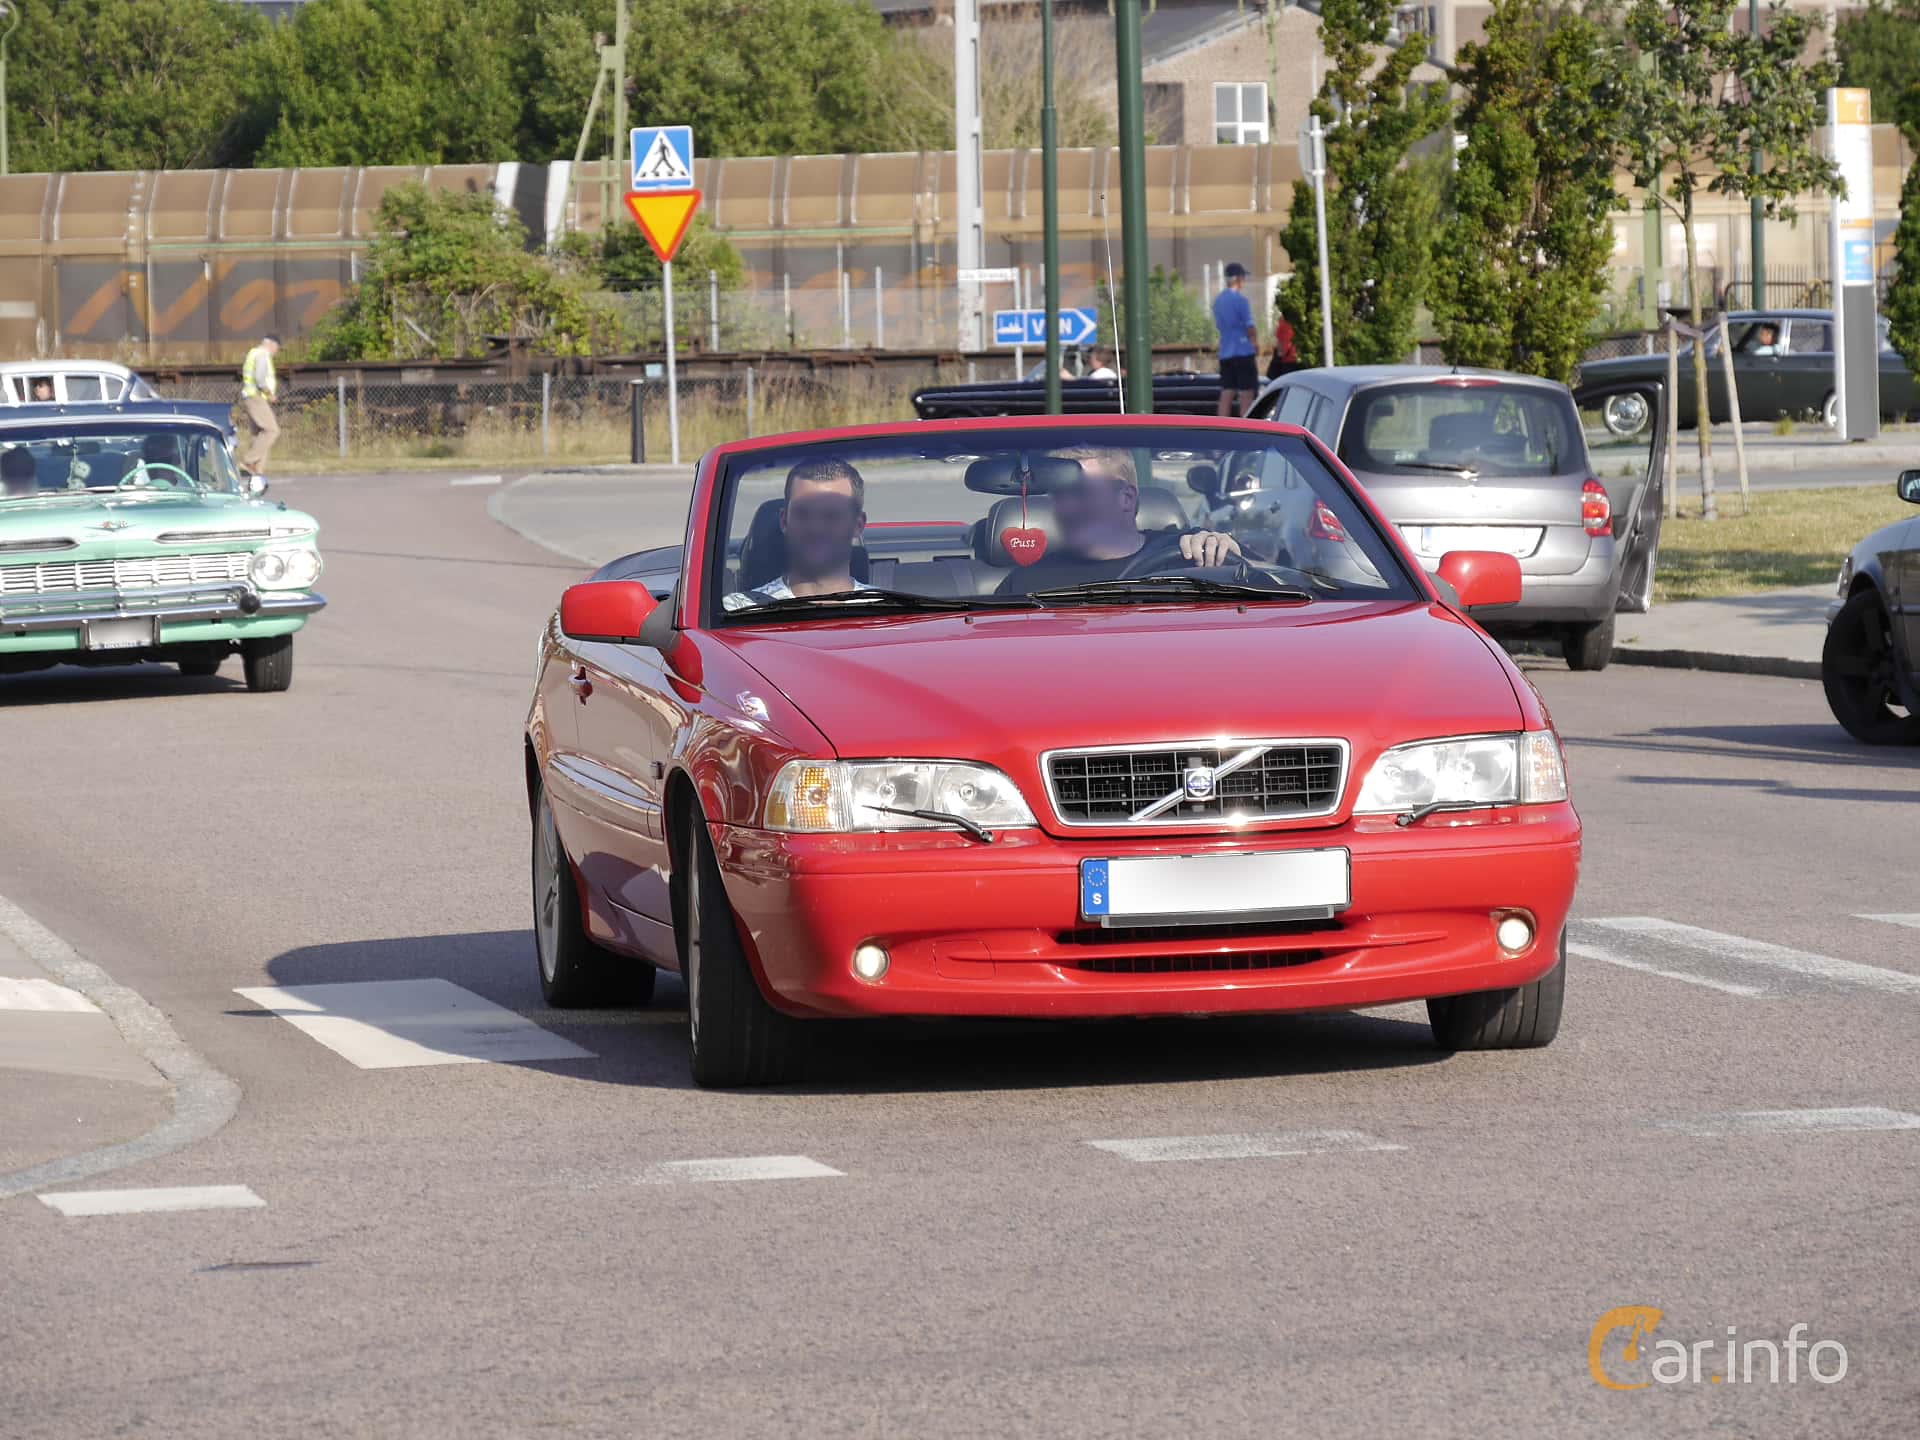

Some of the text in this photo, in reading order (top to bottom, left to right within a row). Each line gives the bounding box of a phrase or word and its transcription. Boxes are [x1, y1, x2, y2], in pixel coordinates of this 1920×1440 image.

[1031, 317, 1072, 336] VN
[1010, 537, 1036, 548] Puss
[1093, 892, 1102, 905] S
